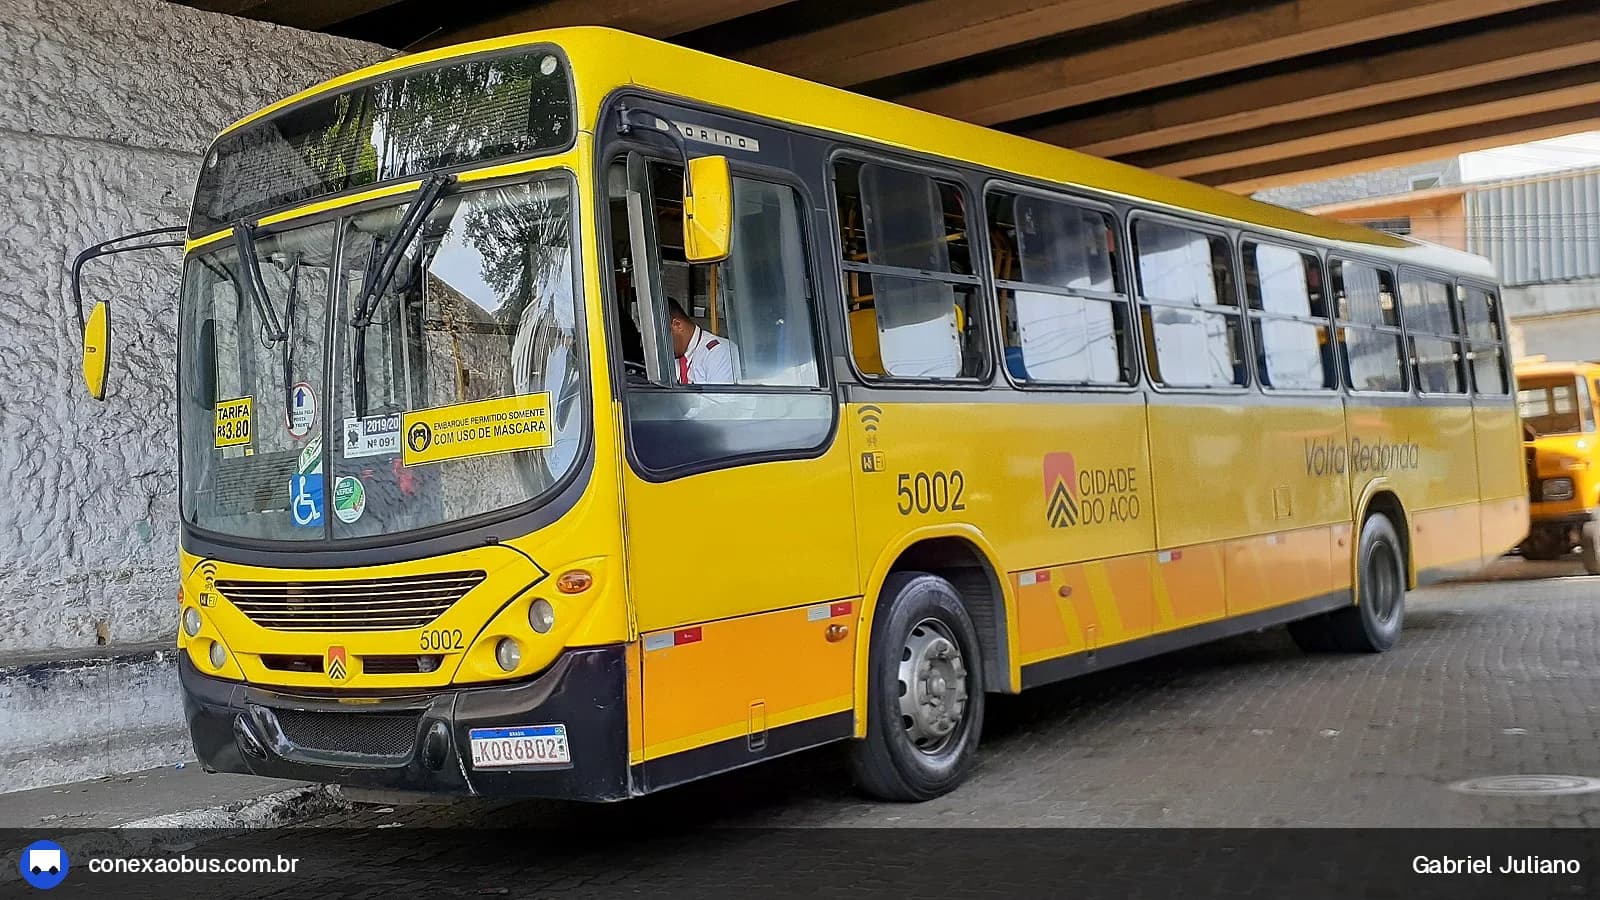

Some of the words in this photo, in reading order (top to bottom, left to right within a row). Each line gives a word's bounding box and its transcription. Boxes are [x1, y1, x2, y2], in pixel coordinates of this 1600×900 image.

[675, 124, 746, 148] ORINO
[217, 404, 249, 420] TARIFA
[434, 418, 469, 431] EMBARQUE
[471, 412, 507, 425] PERMITIDO
[509, 408, 545, 420] SOMENTE
[217, 420, 249, 439] R$3.80
[367, 417, 399, 433] 2019/20
[434, 432, 455, 446] COM
[456, 428, 476, 442] USO
[478, 426, 491, 439] DE
[494, 419, 546, 437] MÁSCARA
[379, 437, 395, 447] 091
[1304, 435, 1346, 476] Volta
[1350, 434, 1419, 473] Redonda
[897, 470, 965, 515] 5002
[1080, 467, 1137, 496] CIDADE
[1081, 498, 1105, 525] DO
[420, 629, 464, 650] 5002
